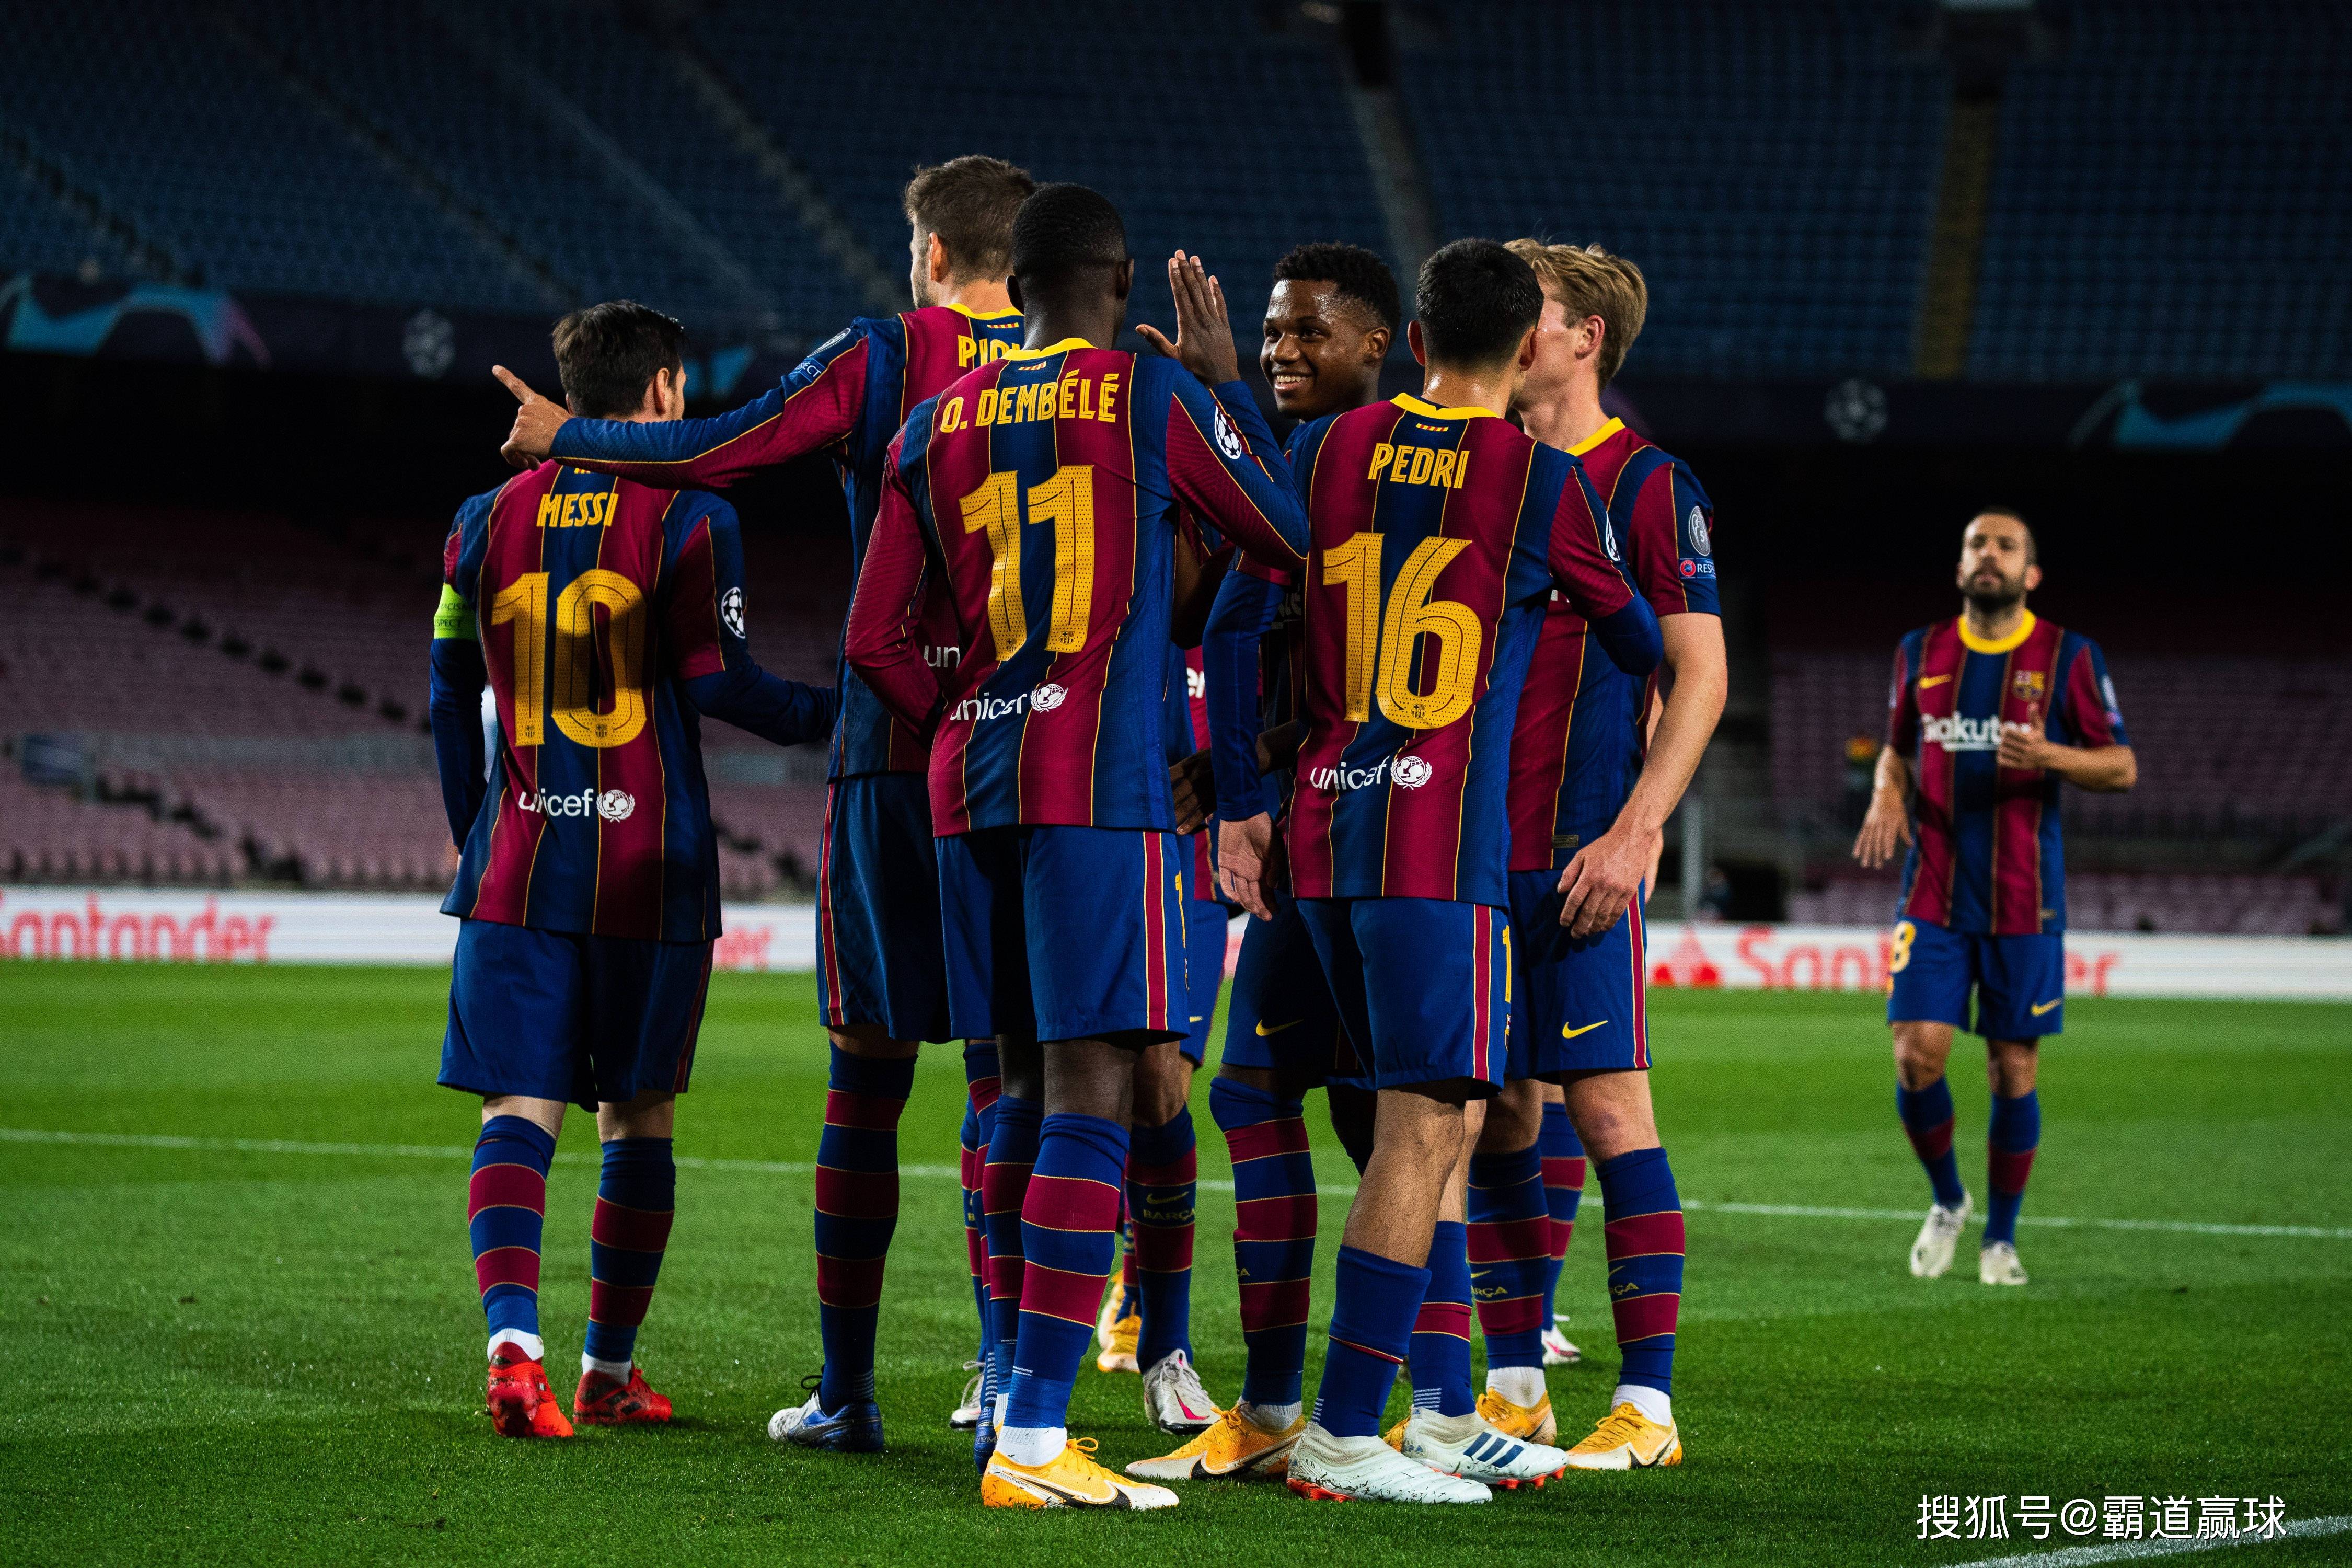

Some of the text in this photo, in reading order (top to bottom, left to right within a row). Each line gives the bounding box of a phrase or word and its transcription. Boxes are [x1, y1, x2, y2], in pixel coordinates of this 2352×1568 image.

[940, 369, 1119, 433] O. DEMBÉLÉ
[1368, 443, 1470, 489] PEDRI
[537, 492, 619, 528] MESSI
[959, 465, 1094, 661] 11
[491, 568, 647, 748] 10
[1323, 532, 1482, 729] 16
[1310, 755, 1390, 790] unicef
